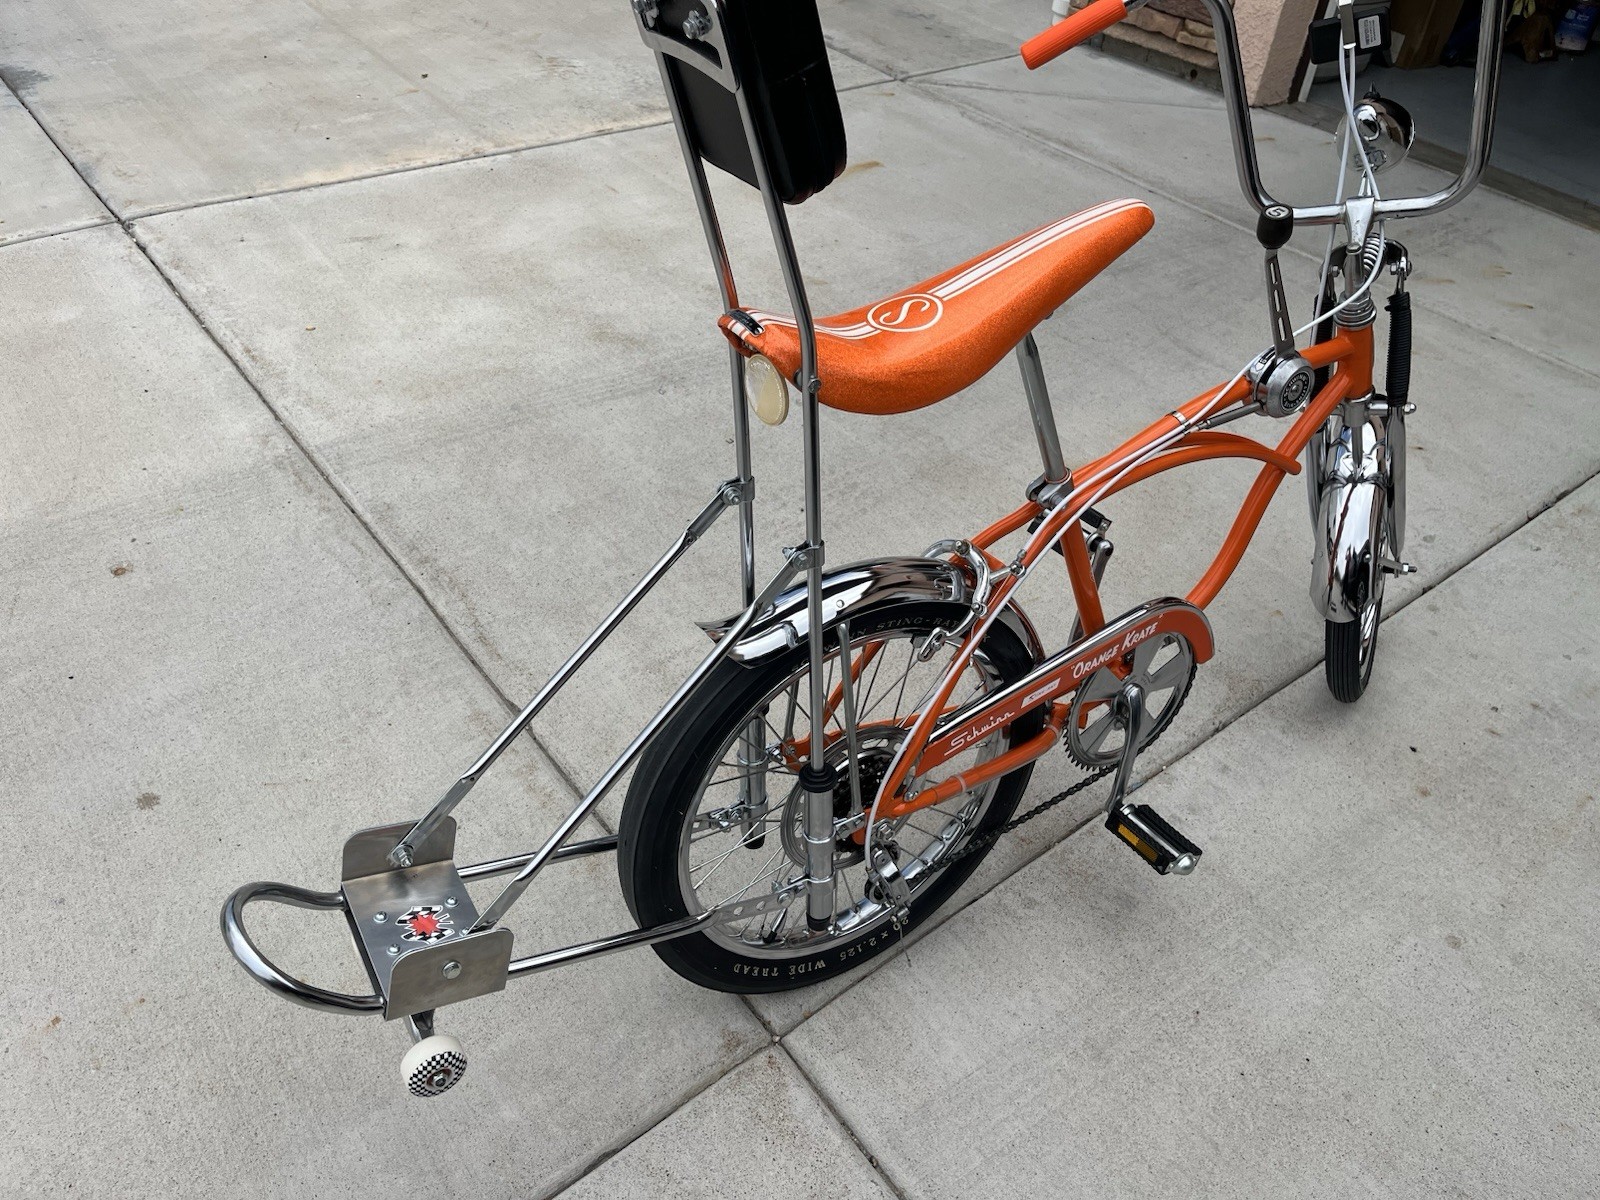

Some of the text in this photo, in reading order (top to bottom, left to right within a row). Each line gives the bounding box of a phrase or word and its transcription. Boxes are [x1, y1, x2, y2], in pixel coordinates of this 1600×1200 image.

[944, 711, 1015, 756] Schwinn
[839, 937, 878, 962] 2.125
[733, 962, 780, 978] TREAD
[788, 958, 827, 976] WIDE
